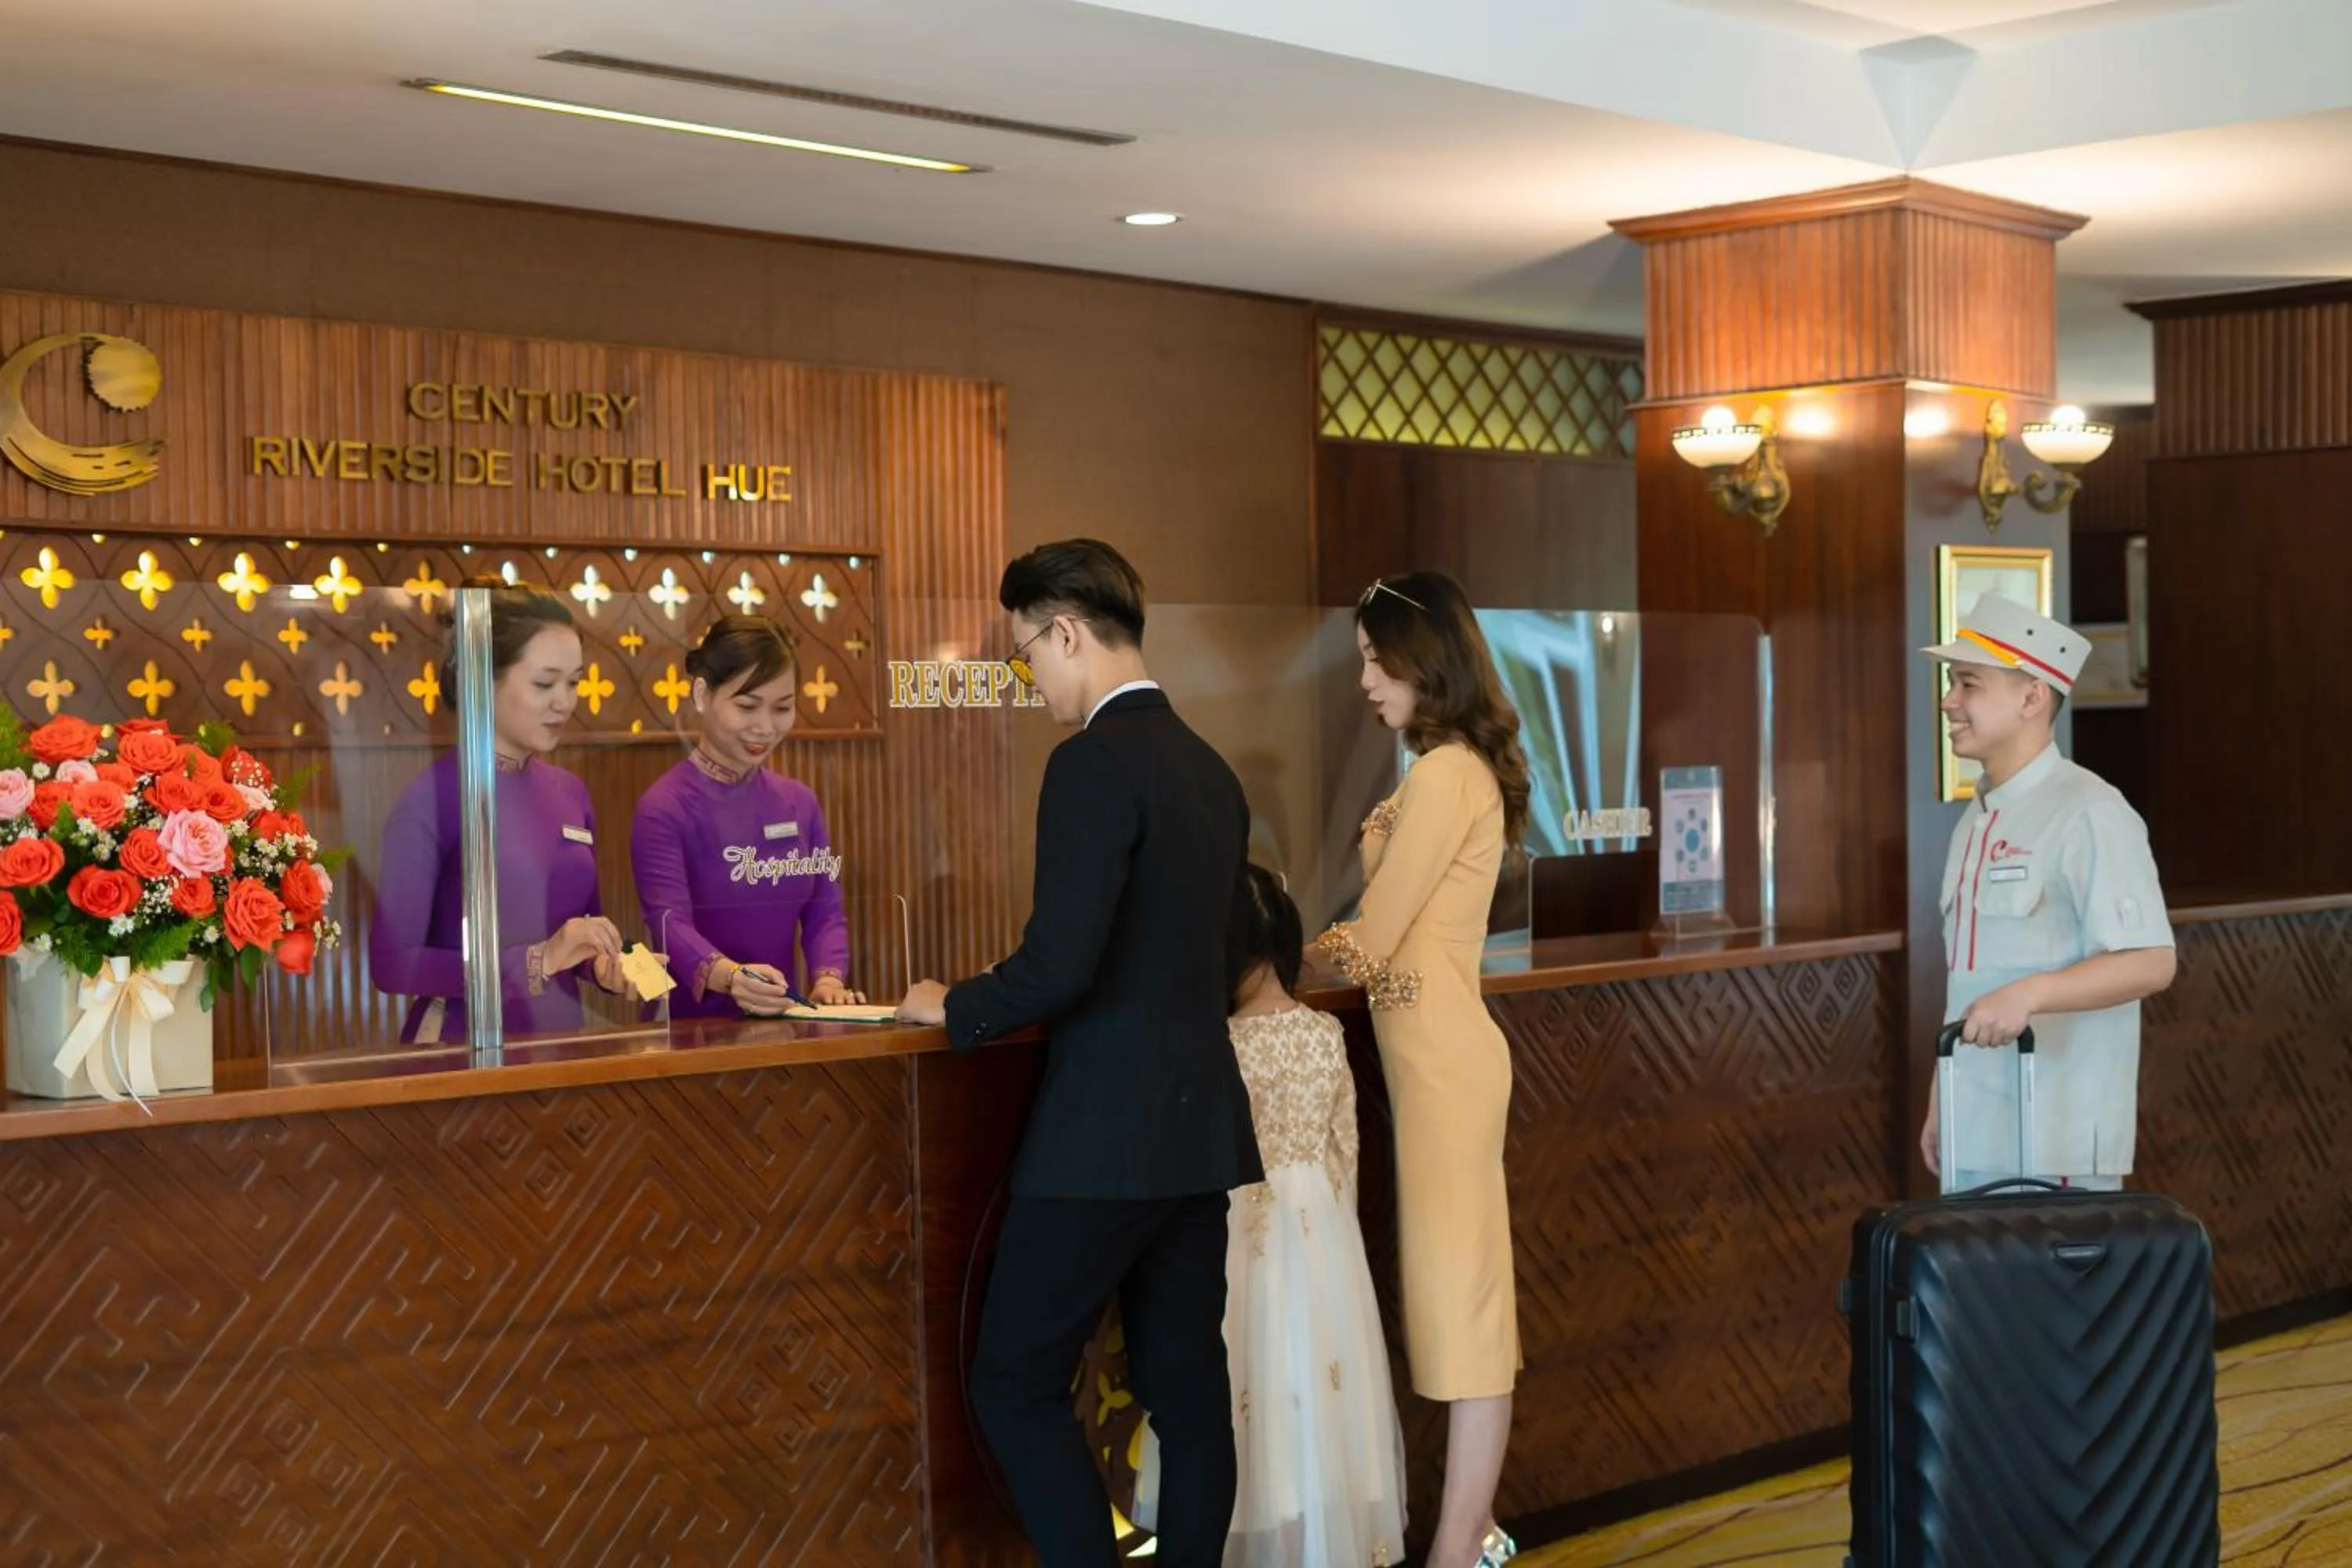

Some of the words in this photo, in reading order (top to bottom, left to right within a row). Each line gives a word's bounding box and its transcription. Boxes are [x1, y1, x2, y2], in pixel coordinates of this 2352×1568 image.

[408, 381, 637, 429] CENTURY
[252, 436, 514, 487] RIVERSIDE
[536, 452, 687, 496] HOTEL
[706, 463, 792, 503] HUE
[723, 845, 842, 885] Hospitality
